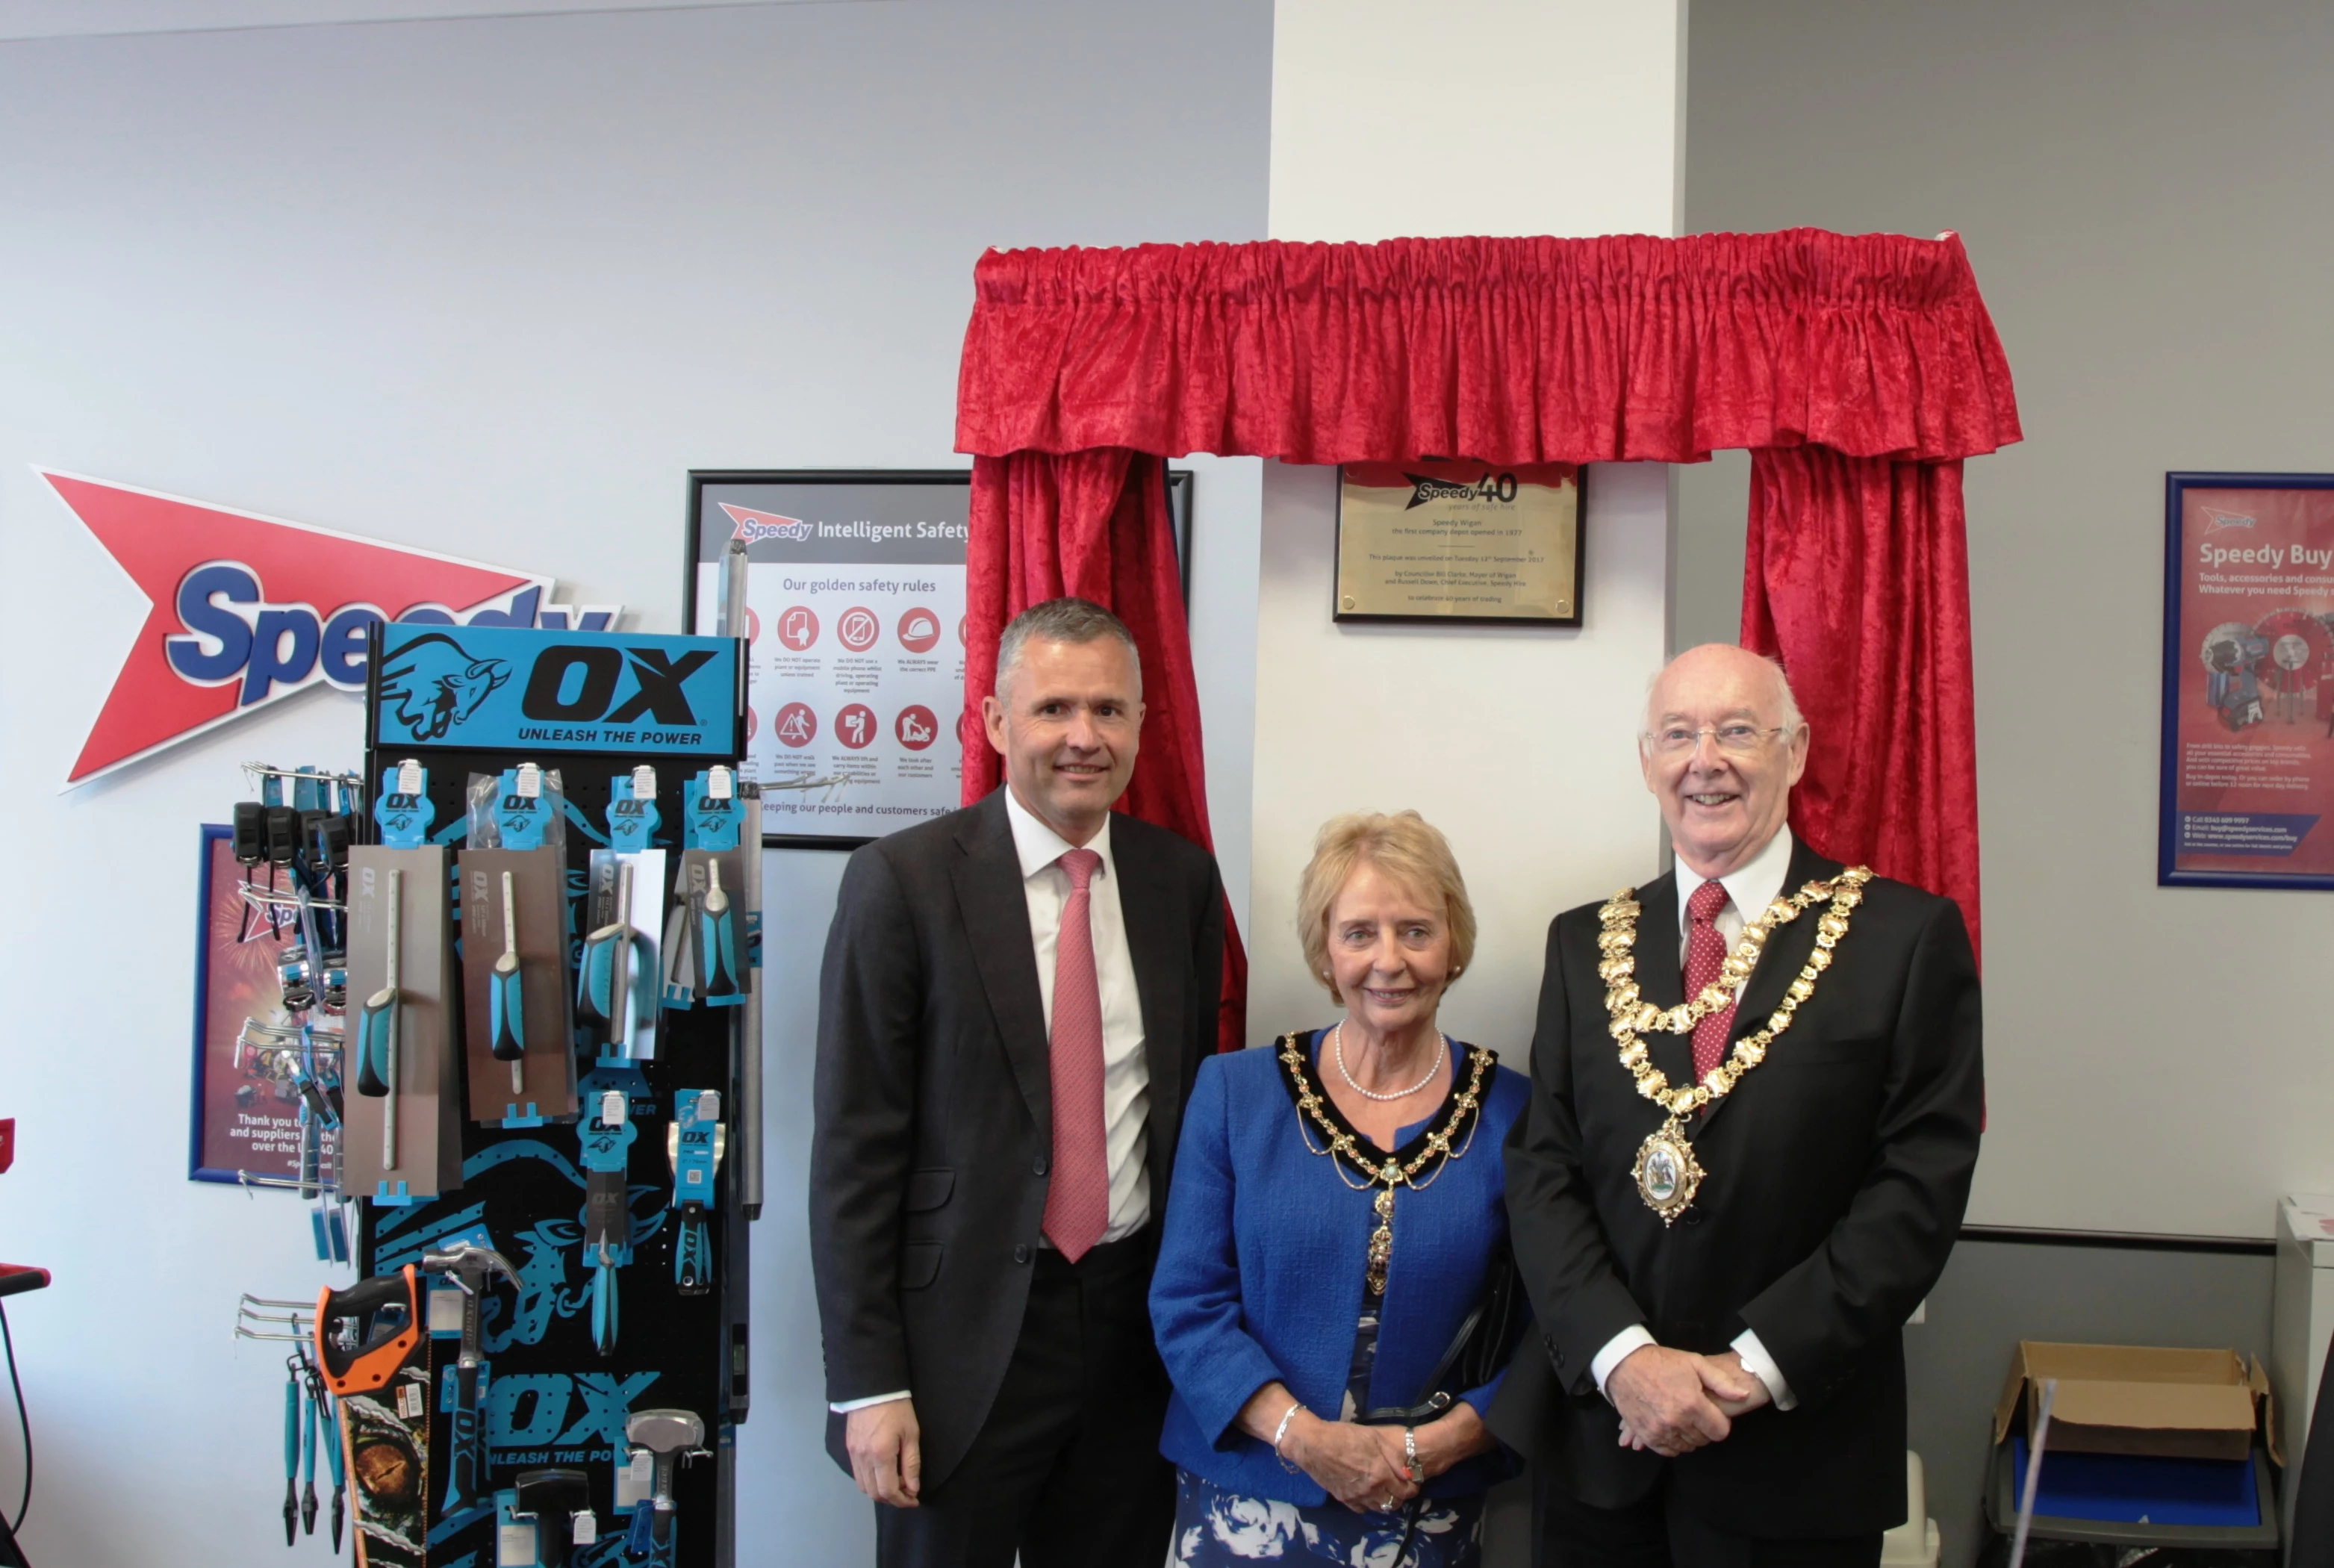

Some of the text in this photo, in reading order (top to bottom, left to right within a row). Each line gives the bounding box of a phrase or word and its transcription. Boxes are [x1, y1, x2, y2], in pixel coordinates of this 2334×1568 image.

[1419, 473, 1517, 503] Speedy 40
[1448, 503, 1469, 511] years
[1472, 503, 1481, 511] of
[1482, 503, 1498, 512] safe
[1433, 519, 1482, 527] Speedy Wigan
[2215, 515, 2256, 528] Speedy
[741, 519, 969, 543] Speedy Intelligent Safety
[1419, 529, 1448, 537] company
[2200, 543, 2333, 570] Speedy Buy
[2200, 573, 2303, 583] Tools, accessories and
[783, 579, 936, 595] Our golden safety rules
[2199, 585, 2244, 594] Whatever
[2247, 586, 2265, 597] you
[2267, 585, 2291, 595] need
[2293, 585, 2329, 598] Speedy
[521, 644, 720, 726] OX
[518, 727, 702, 745] UNLEASH THE POWER
[386, 793, 423, 809] OX
[504, 794, 538, 810] OX
[615, 799, 648, 815] OX
[698, 796, 735, 811] OX
[762, 801, 951, 816] eeping our people and customers safe
[362, 866, 376, 899] OX
[473, 870, 489, 903] OX
[599, 863, 614, 896] OX
[691, 863, 706, 895] OX
[238, 1113, 292, 1129] Thank you
[230, 1127, 300, 1142] and suppliers
[682, 1131, 711, 1144] OX
[252, 1142, 334, 1155] over the 40
[591, 1192, 619, 1204] OX
[684, 1232, 697, 1263] OX
[488, 1371, 662, 1446] OX
[455, 1410, 476, 1460] OX
[490, 1451, 547, 1464] NLEASH
[554, 1452, 578, 1463] THE
